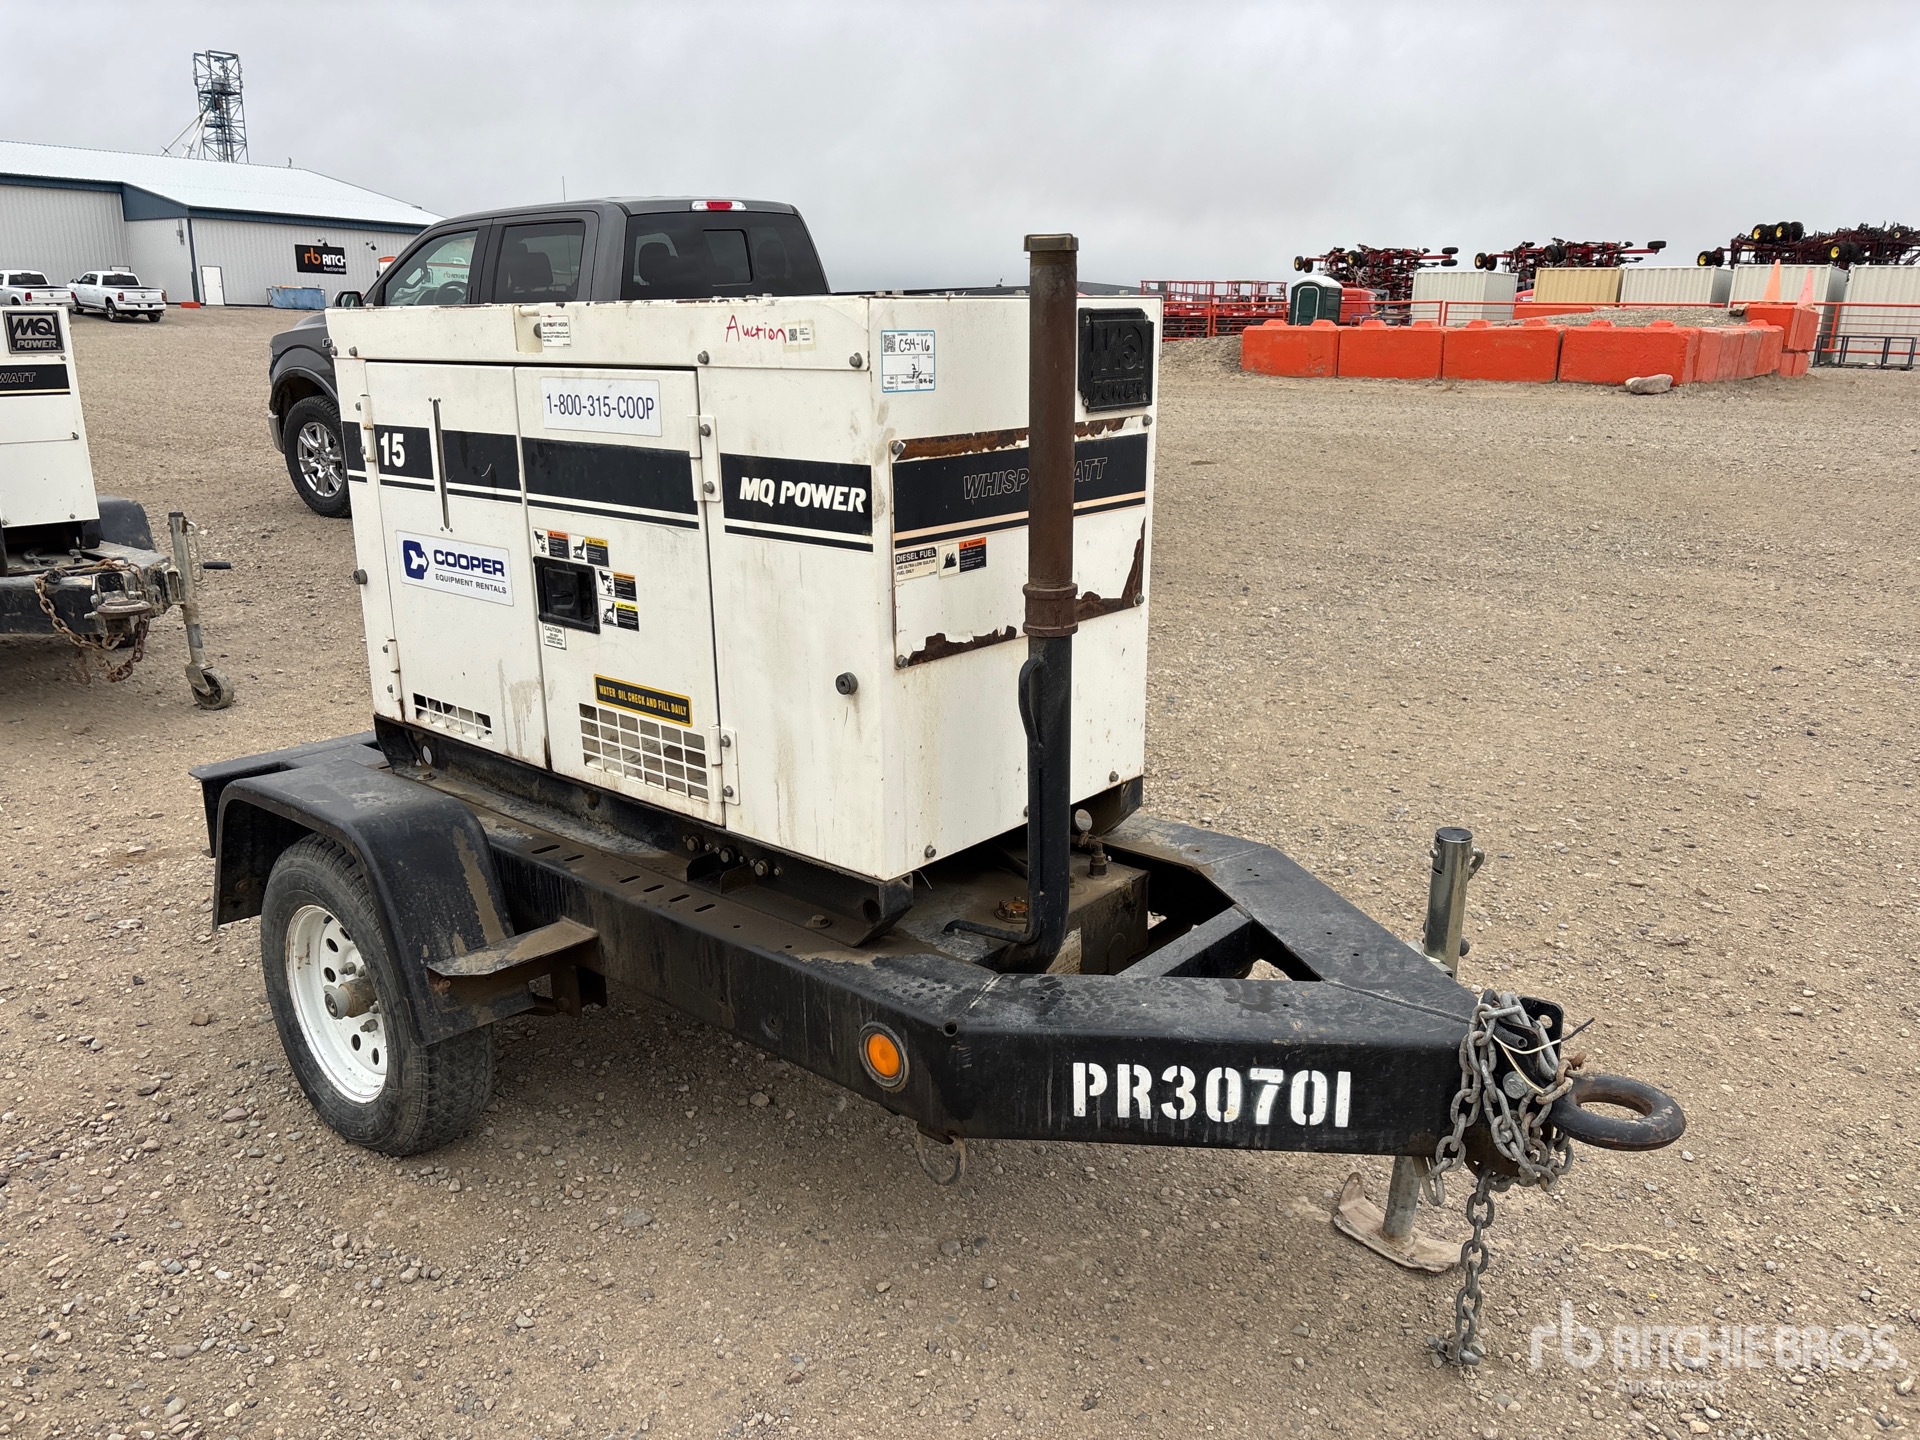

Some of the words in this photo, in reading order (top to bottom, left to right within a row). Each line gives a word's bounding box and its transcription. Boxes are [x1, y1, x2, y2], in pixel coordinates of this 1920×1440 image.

[304, 247, 321, 265] rb
[14, 318, 56, 335] MQ
[725, 314, 787, 344] Auction
[16, 340, 57, 349] POWER
[546, 393, 655, 420] 1-800-315-COOP
[379, 432, 406, 468] 15
[739, 476, 776, 507] MQ
[779, 480, 867, 513] POWER
[433, 549, 505, 577] COOPER
[896, 552, 919, 563] DIESEL
[919, 549, 936, 559] FUEL
[435, 573, 474, 588] EQUIPMENT
[475, 581, 507, 595] RENTALS
[598, 684, 616, 698] WATER
[617, 689, 627, 701] OIL
[627, 692, 646, 706] CHECK
[646, 697, 657, 708] AND
[658, 699, 670, 712] FILL
[670, 703, 687, 716] DAILY
